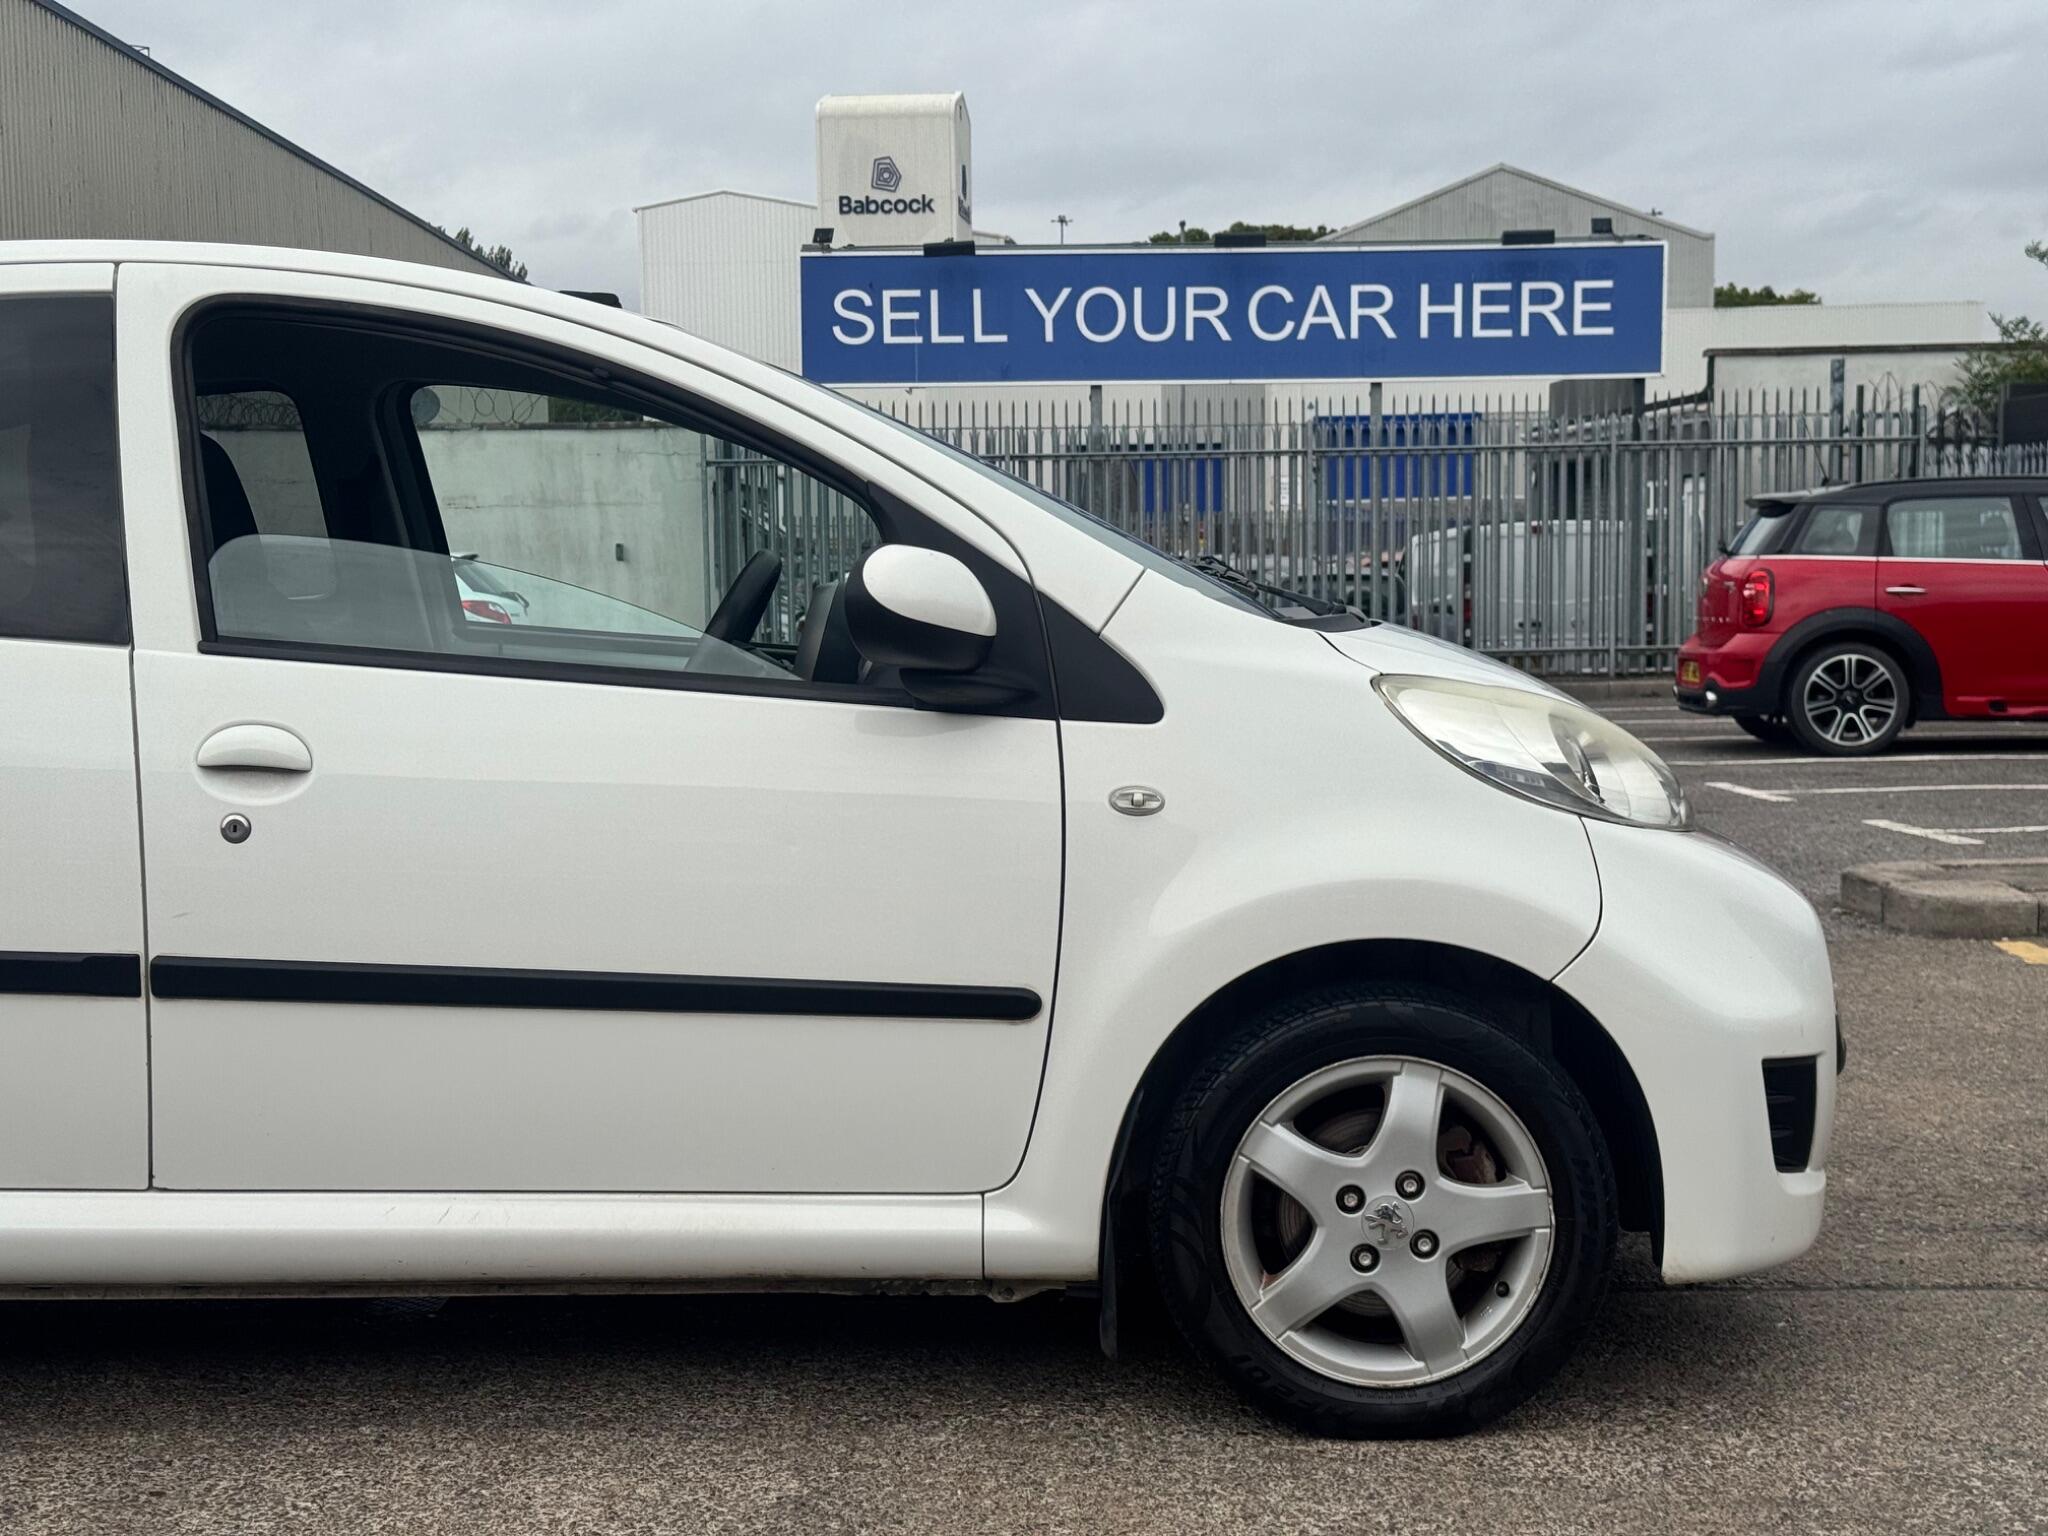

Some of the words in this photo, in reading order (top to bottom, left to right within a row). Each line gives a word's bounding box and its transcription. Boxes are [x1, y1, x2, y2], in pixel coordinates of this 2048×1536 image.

[838, 194, 935, 215] Babcock
[832, 288, 1008, 345] SELL
[1025, 286, 1232, 343] YOUR
[1248, 284, 1397, 342] CAR
[1419, 279, 1614, 339] HERE
